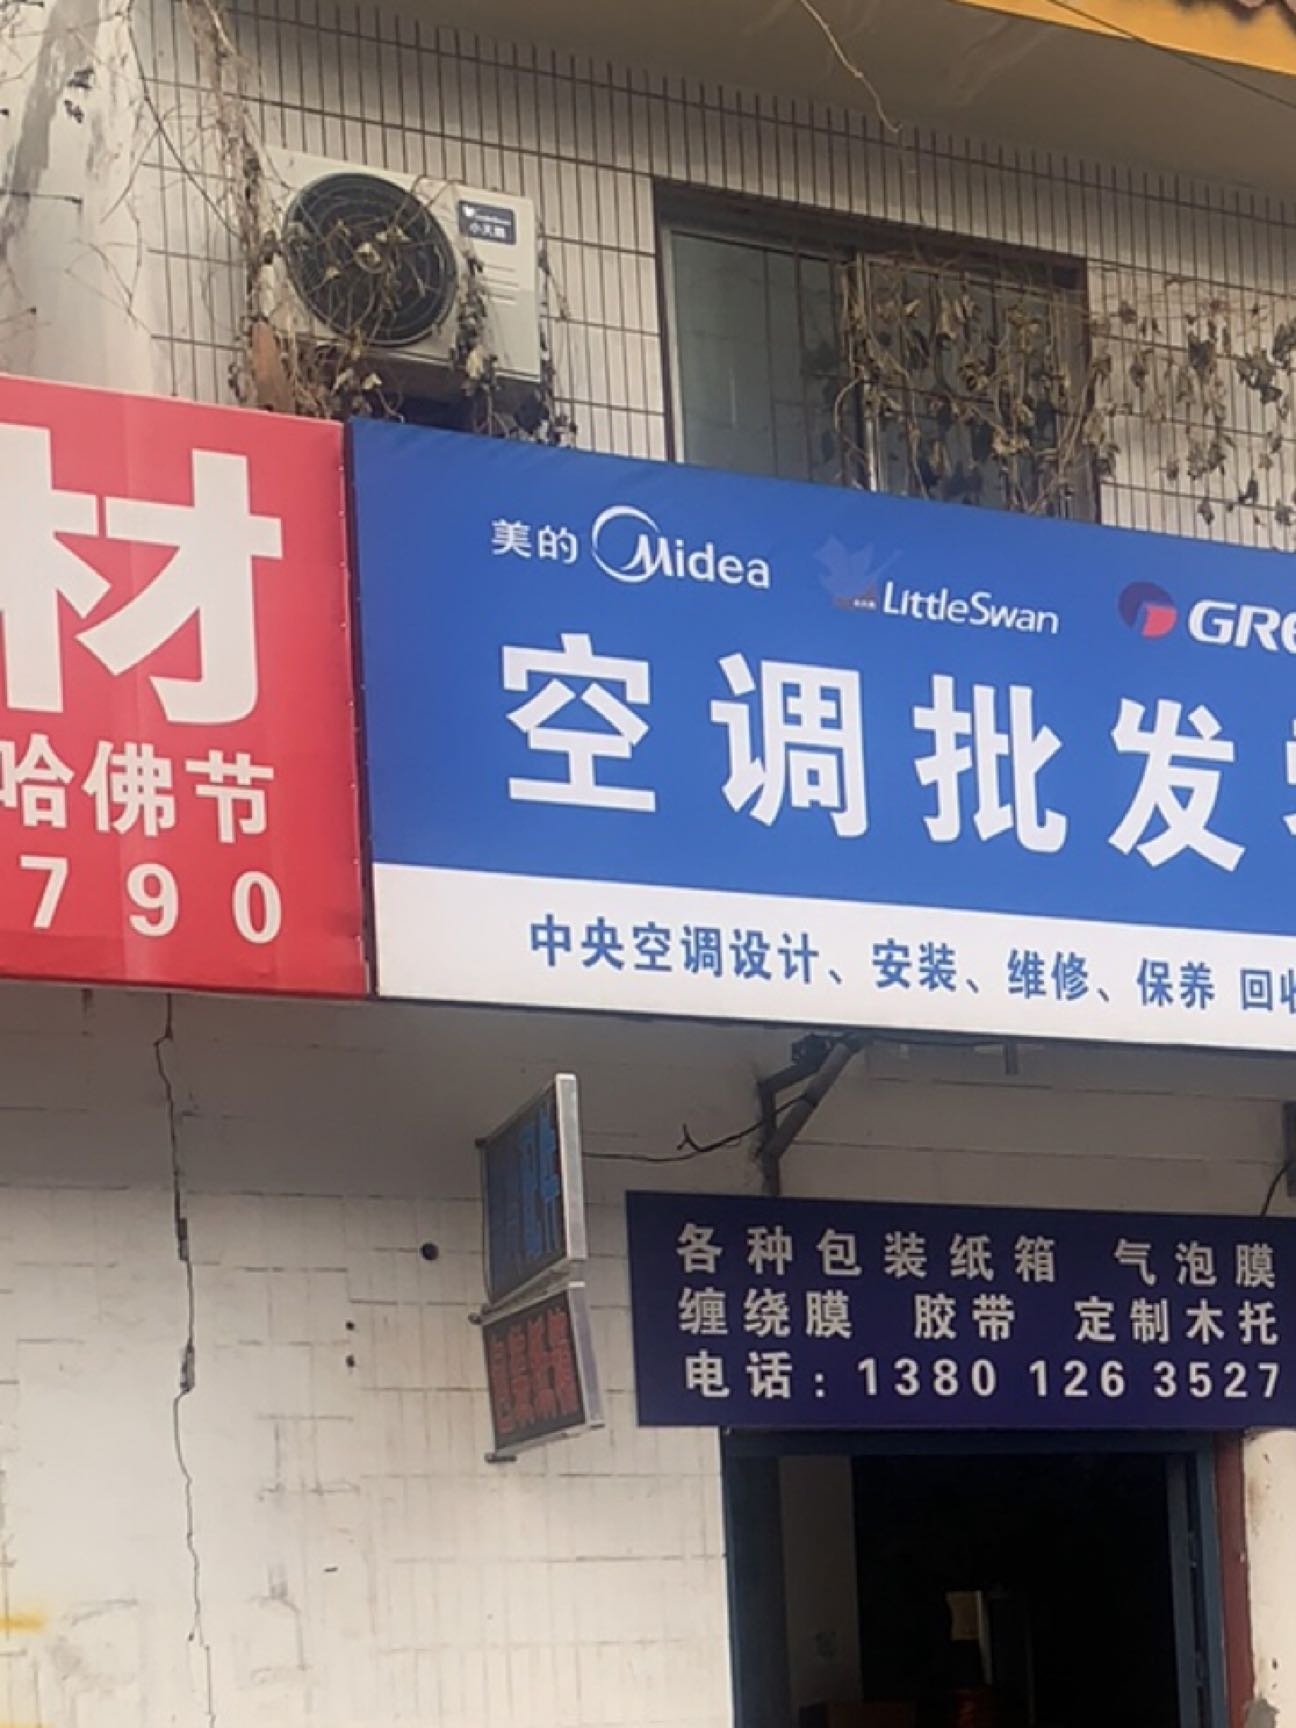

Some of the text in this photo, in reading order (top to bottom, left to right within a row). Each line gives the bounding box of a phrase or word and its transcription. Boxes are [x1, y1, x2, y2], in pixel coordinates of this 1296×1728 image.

[491, 519, 578, 564] 美的
[593, 506, 771, 589] Midea
[0, 422, 283, 725] 材
[883, 581, 1059, 634] LittleSwan
[0, 733, 275, 845] 哈佛节
[676, 1223, 1277, 1289] 各种包装纸箱 气泡膜
[677, 1287, 1279, 1345] 缠绕膜 胶带 定制木托
[857, 1357, 997, 1397] 1380
[1029, 1359, 1125, 1398] 126
[1153, 1361, 1279, 1399] 3527
